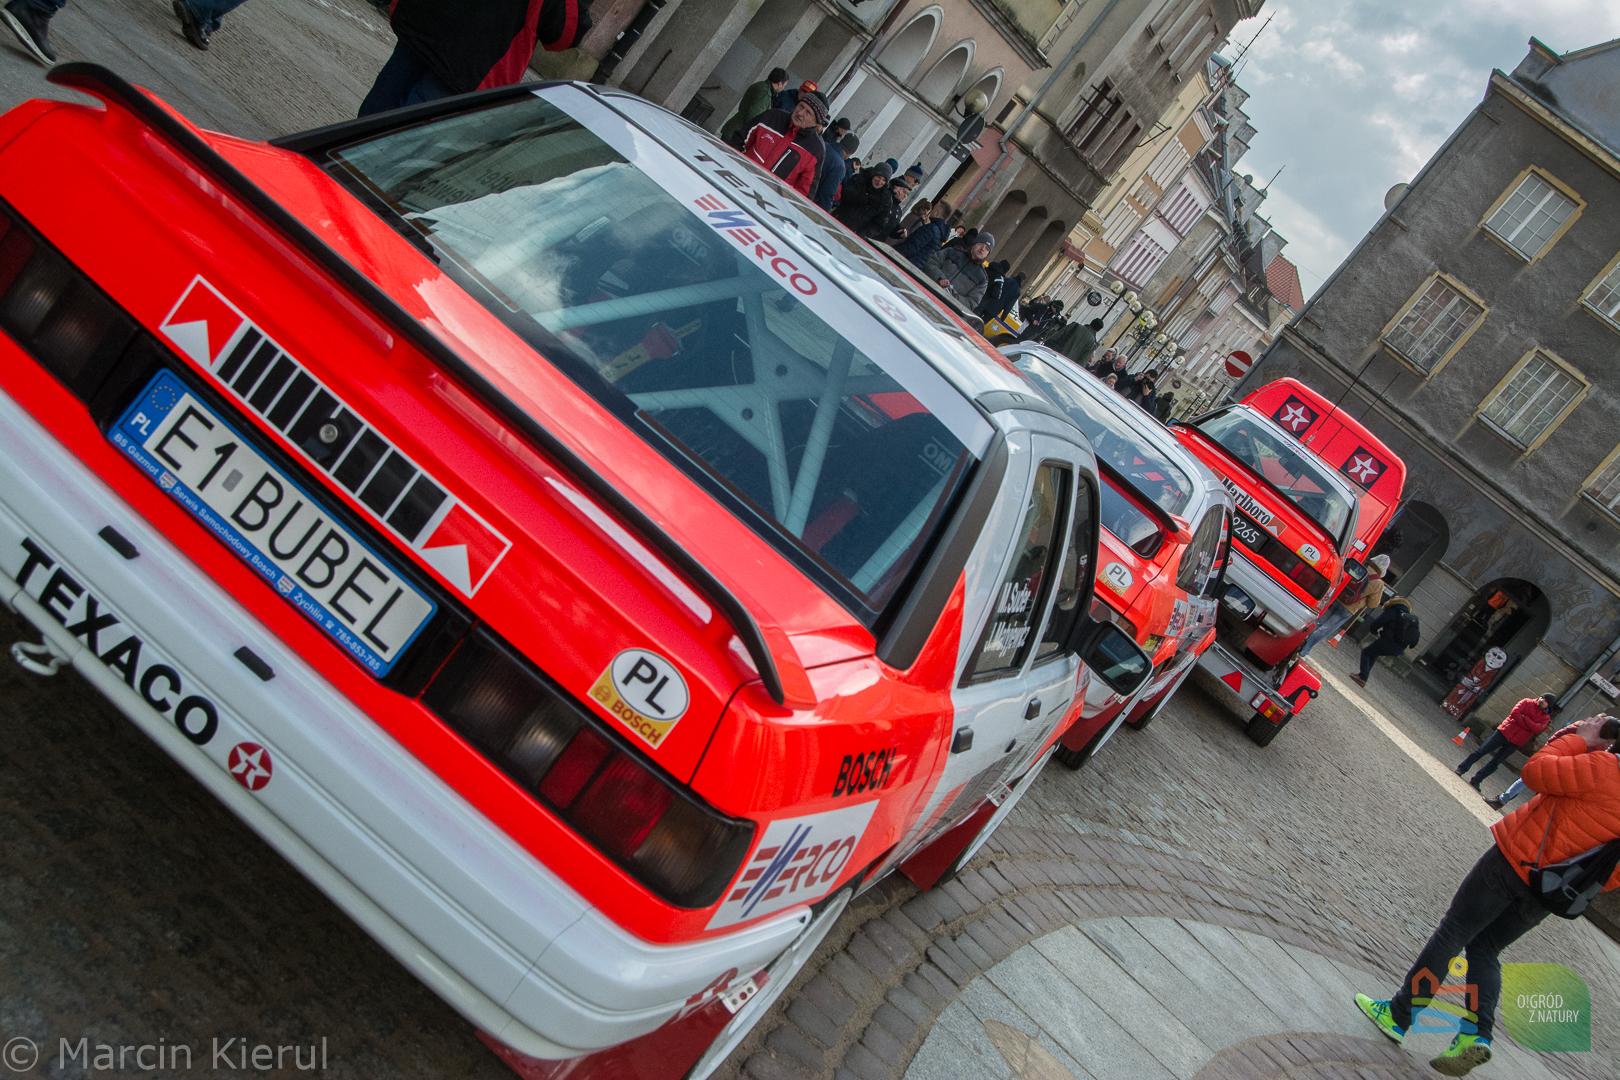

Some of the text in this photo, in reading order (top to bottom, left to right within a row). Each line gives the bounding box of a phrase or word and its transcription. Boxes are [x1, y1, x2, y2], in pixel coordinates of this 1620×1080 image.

[131, 412, 151, 436] PL
[922, 441, 951, 472] OM
[1221, 478, 1272, 526] Marlboro
[113, 433, 127, 448] BS
[127, 445, 159, 476] Gazmot
[173, 486, 199, 512] Serwis
[199, 508, 252, 558] Samochodowy
[251, 555, 276, 579] Bosch
[293, 592, 324, 622] Żychlin
[154, 404, 404, 653] E1 BUBEL
[1109, 564, 1127, 586] PL
[1305, 546, 1316, 560] PL
[16, 537, 219, 746] TEXACO
[621, 656, 671, 715] PL
[611, 700, 662, 745] BOSCH
[832, 747, 897, 797] BOSCH
